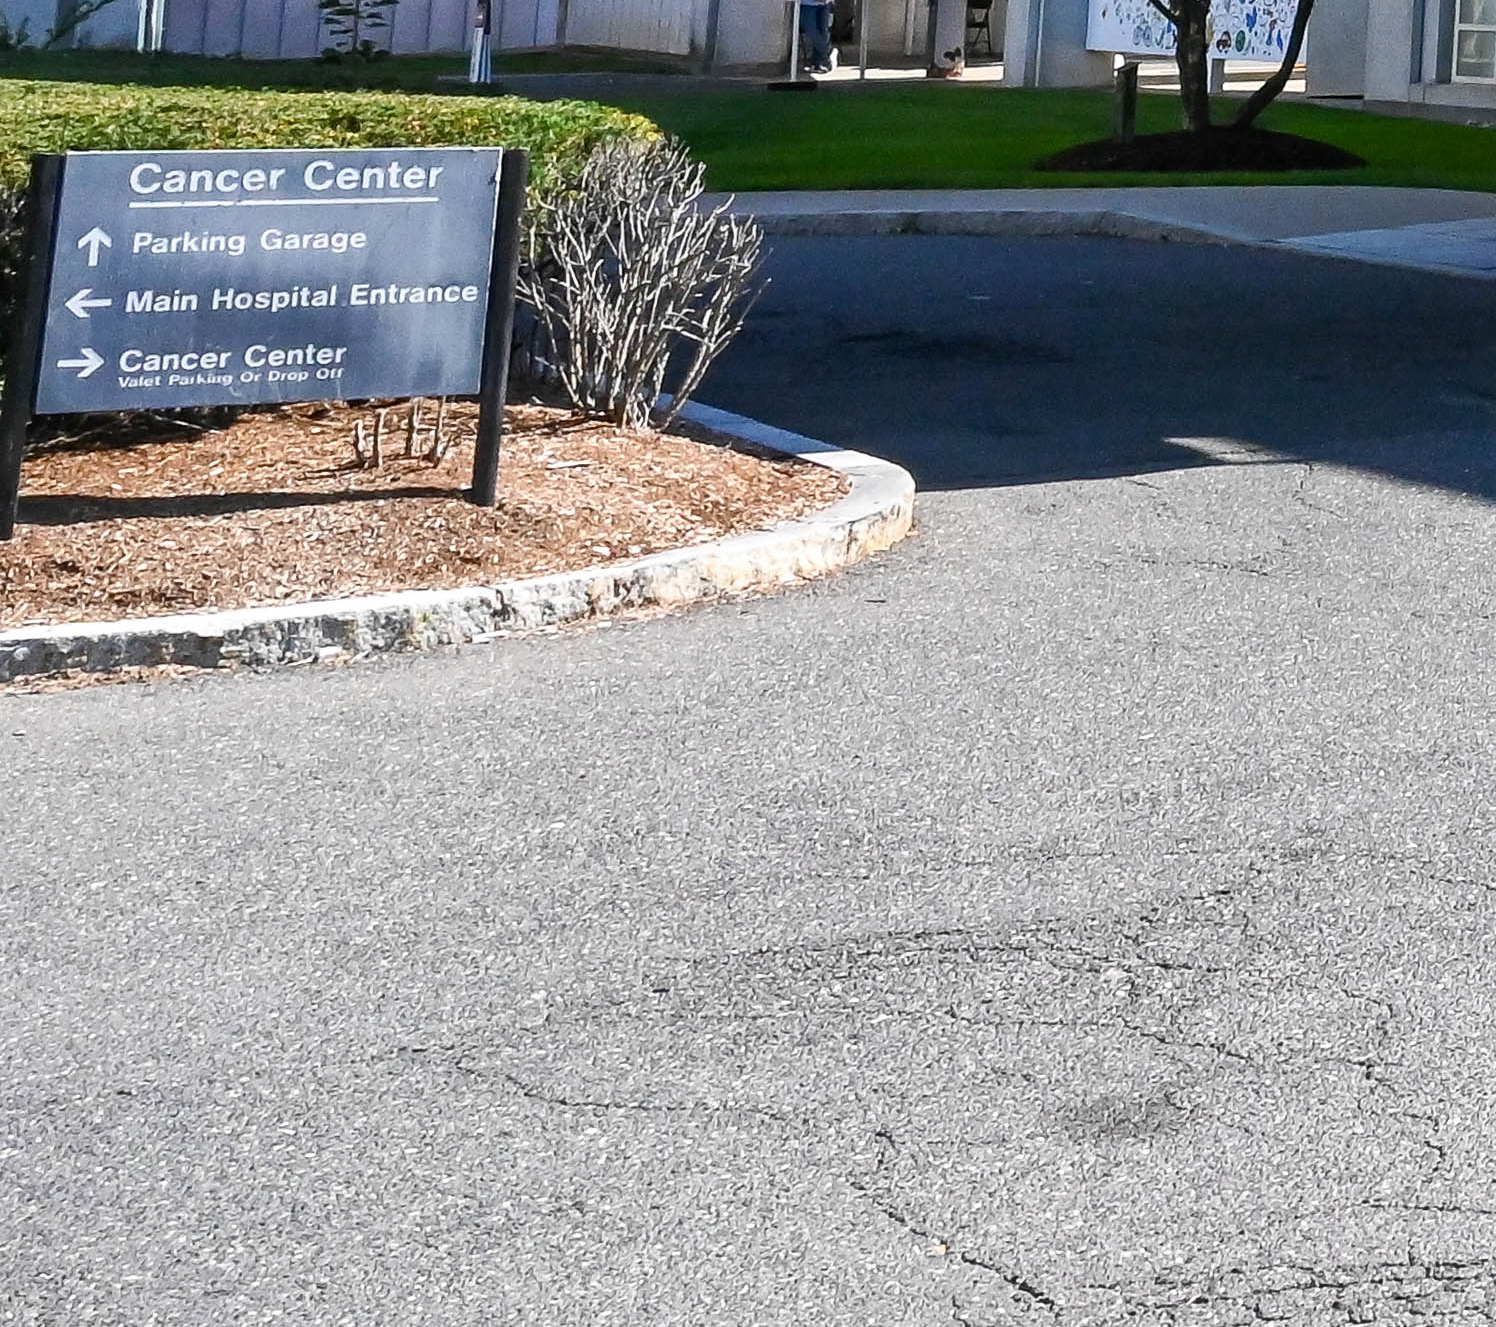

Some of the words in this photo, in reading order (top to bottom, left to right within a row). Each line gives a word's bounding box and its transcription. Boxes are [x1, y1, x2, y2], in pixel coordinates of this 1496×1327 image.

[129, 162, 285, 195] Cancer
[304, 159, 444, 191] Center
[133, 230, 246, 255] Parking
[260, 229, 367, 253] Garage
[125, 289, 198, 313] Main
[212, 285, 337, 313] Hospital
[350, 283, 478, 308] Entrance
[120, 349, 232, 372] Cancer
[244, 344, 347, 368] Center
[118, 375, 161, 388] Valet
[168, 373, 233, 386] Parking
[240, 370, 262, 383] Or
[268, 370, 309, 383] Drop
[316, 367, 344, 380] Off
